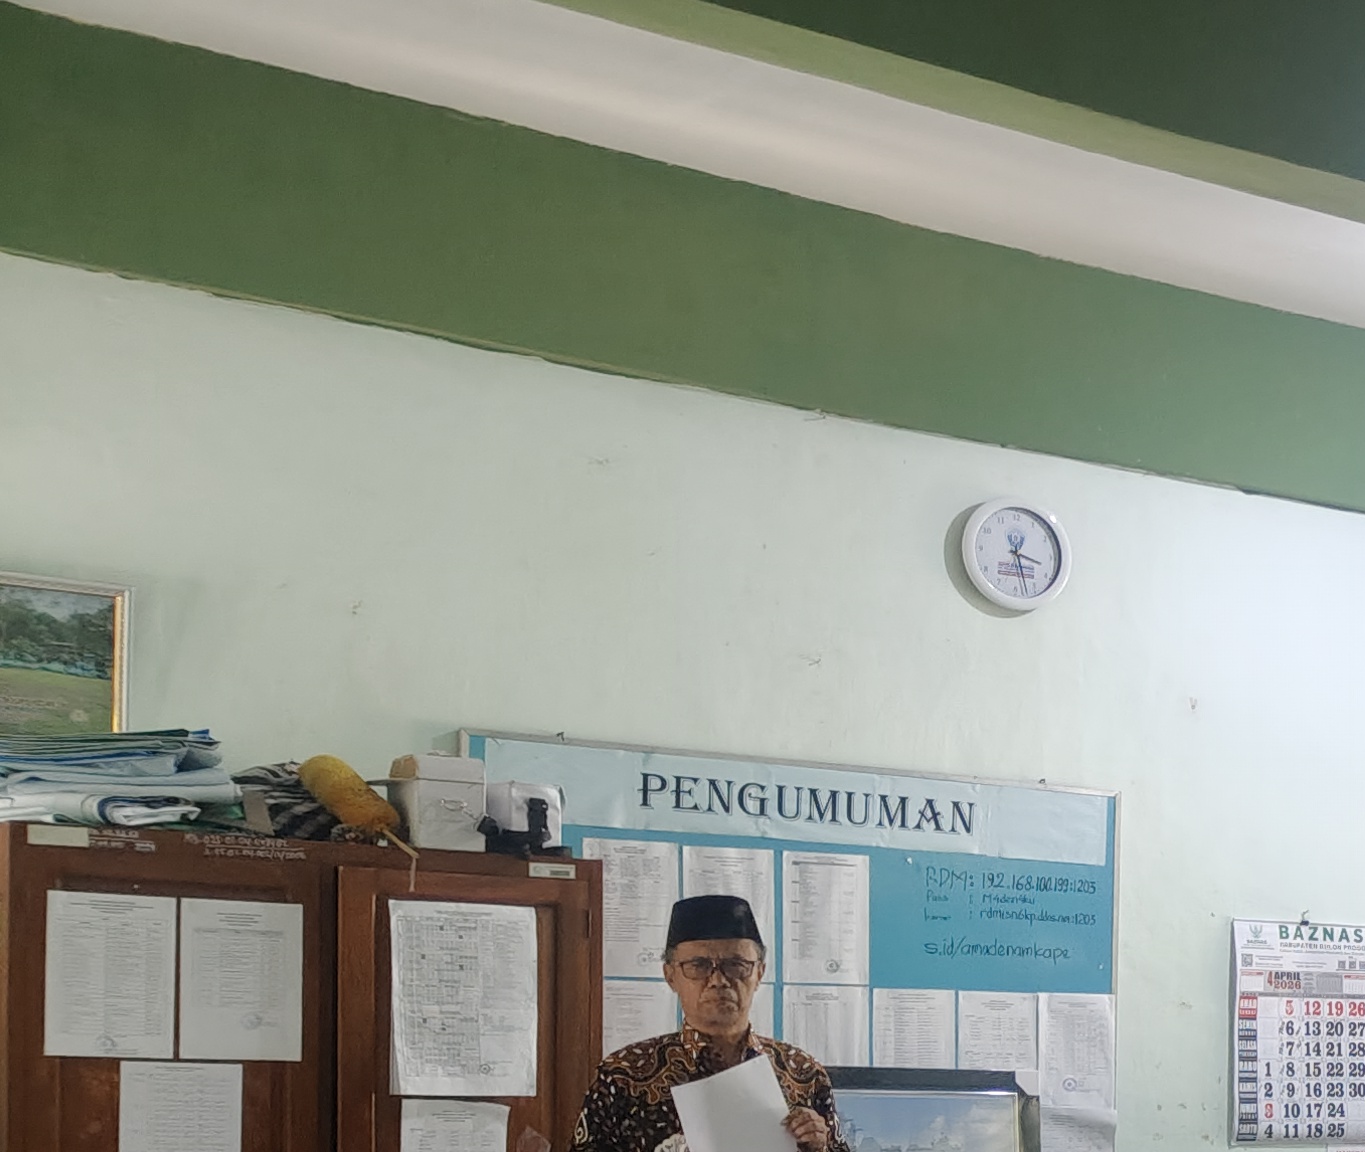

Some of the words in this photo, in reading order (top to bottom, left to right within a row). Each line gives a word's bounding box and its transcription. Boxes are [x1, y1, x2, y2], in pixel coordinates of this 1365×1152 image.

[637, 772, 975, 836] PENGUMUMAN
[1278, 925, 1364, 943] BAZNAS
[1274, 972, 1301, 981] APRIL
[1274, 980, 1301, 990] 2026
[1305, 1001, 1322, 1016] 12
[1327, 1001, 1344, 1016] 19
[1286, 1020, 1294, 1036] 6
[1305, 1021, 1322, 1036] 13
[1326, 1021, 1344, 1036] 20
[1349, 1022, 1365, 1037] 27
[1286, 1041, 1295, 1056] 7
[1305, 1042, 1322, 1056] 14
[1326, 1042, 1343, 1057] 21
[1349, 1042, 1365, 1057] 28
[1265, 1062, 1272, 1077] 1
[1286, 1062, 1295, 1077] 8
[1306, 1062, 1322, 1077] 15
[1327, 1062, 1344, 1077] 22
[1349, 1062, 1365, 1078] 29
[1264, 1083, 1274, 1098] 2
[1287, 1083, 1295, 1098] 9
[1306, 1083, 1322, 1098] 16
[1327, 1083, 1345, 1098] 23
[1284, 1103, 1300, 1118] 10
[1306, 1103, 1323, 1118] 17
[1328, 1103, 1346, 1118] 24
[1264, 1124, 1274, 1139] 4
[1284, 1124, 1299, 1139] 11
[1307, 1124, 1323, 1139] 18
[1327, 1123, 1345, 1138] 25
